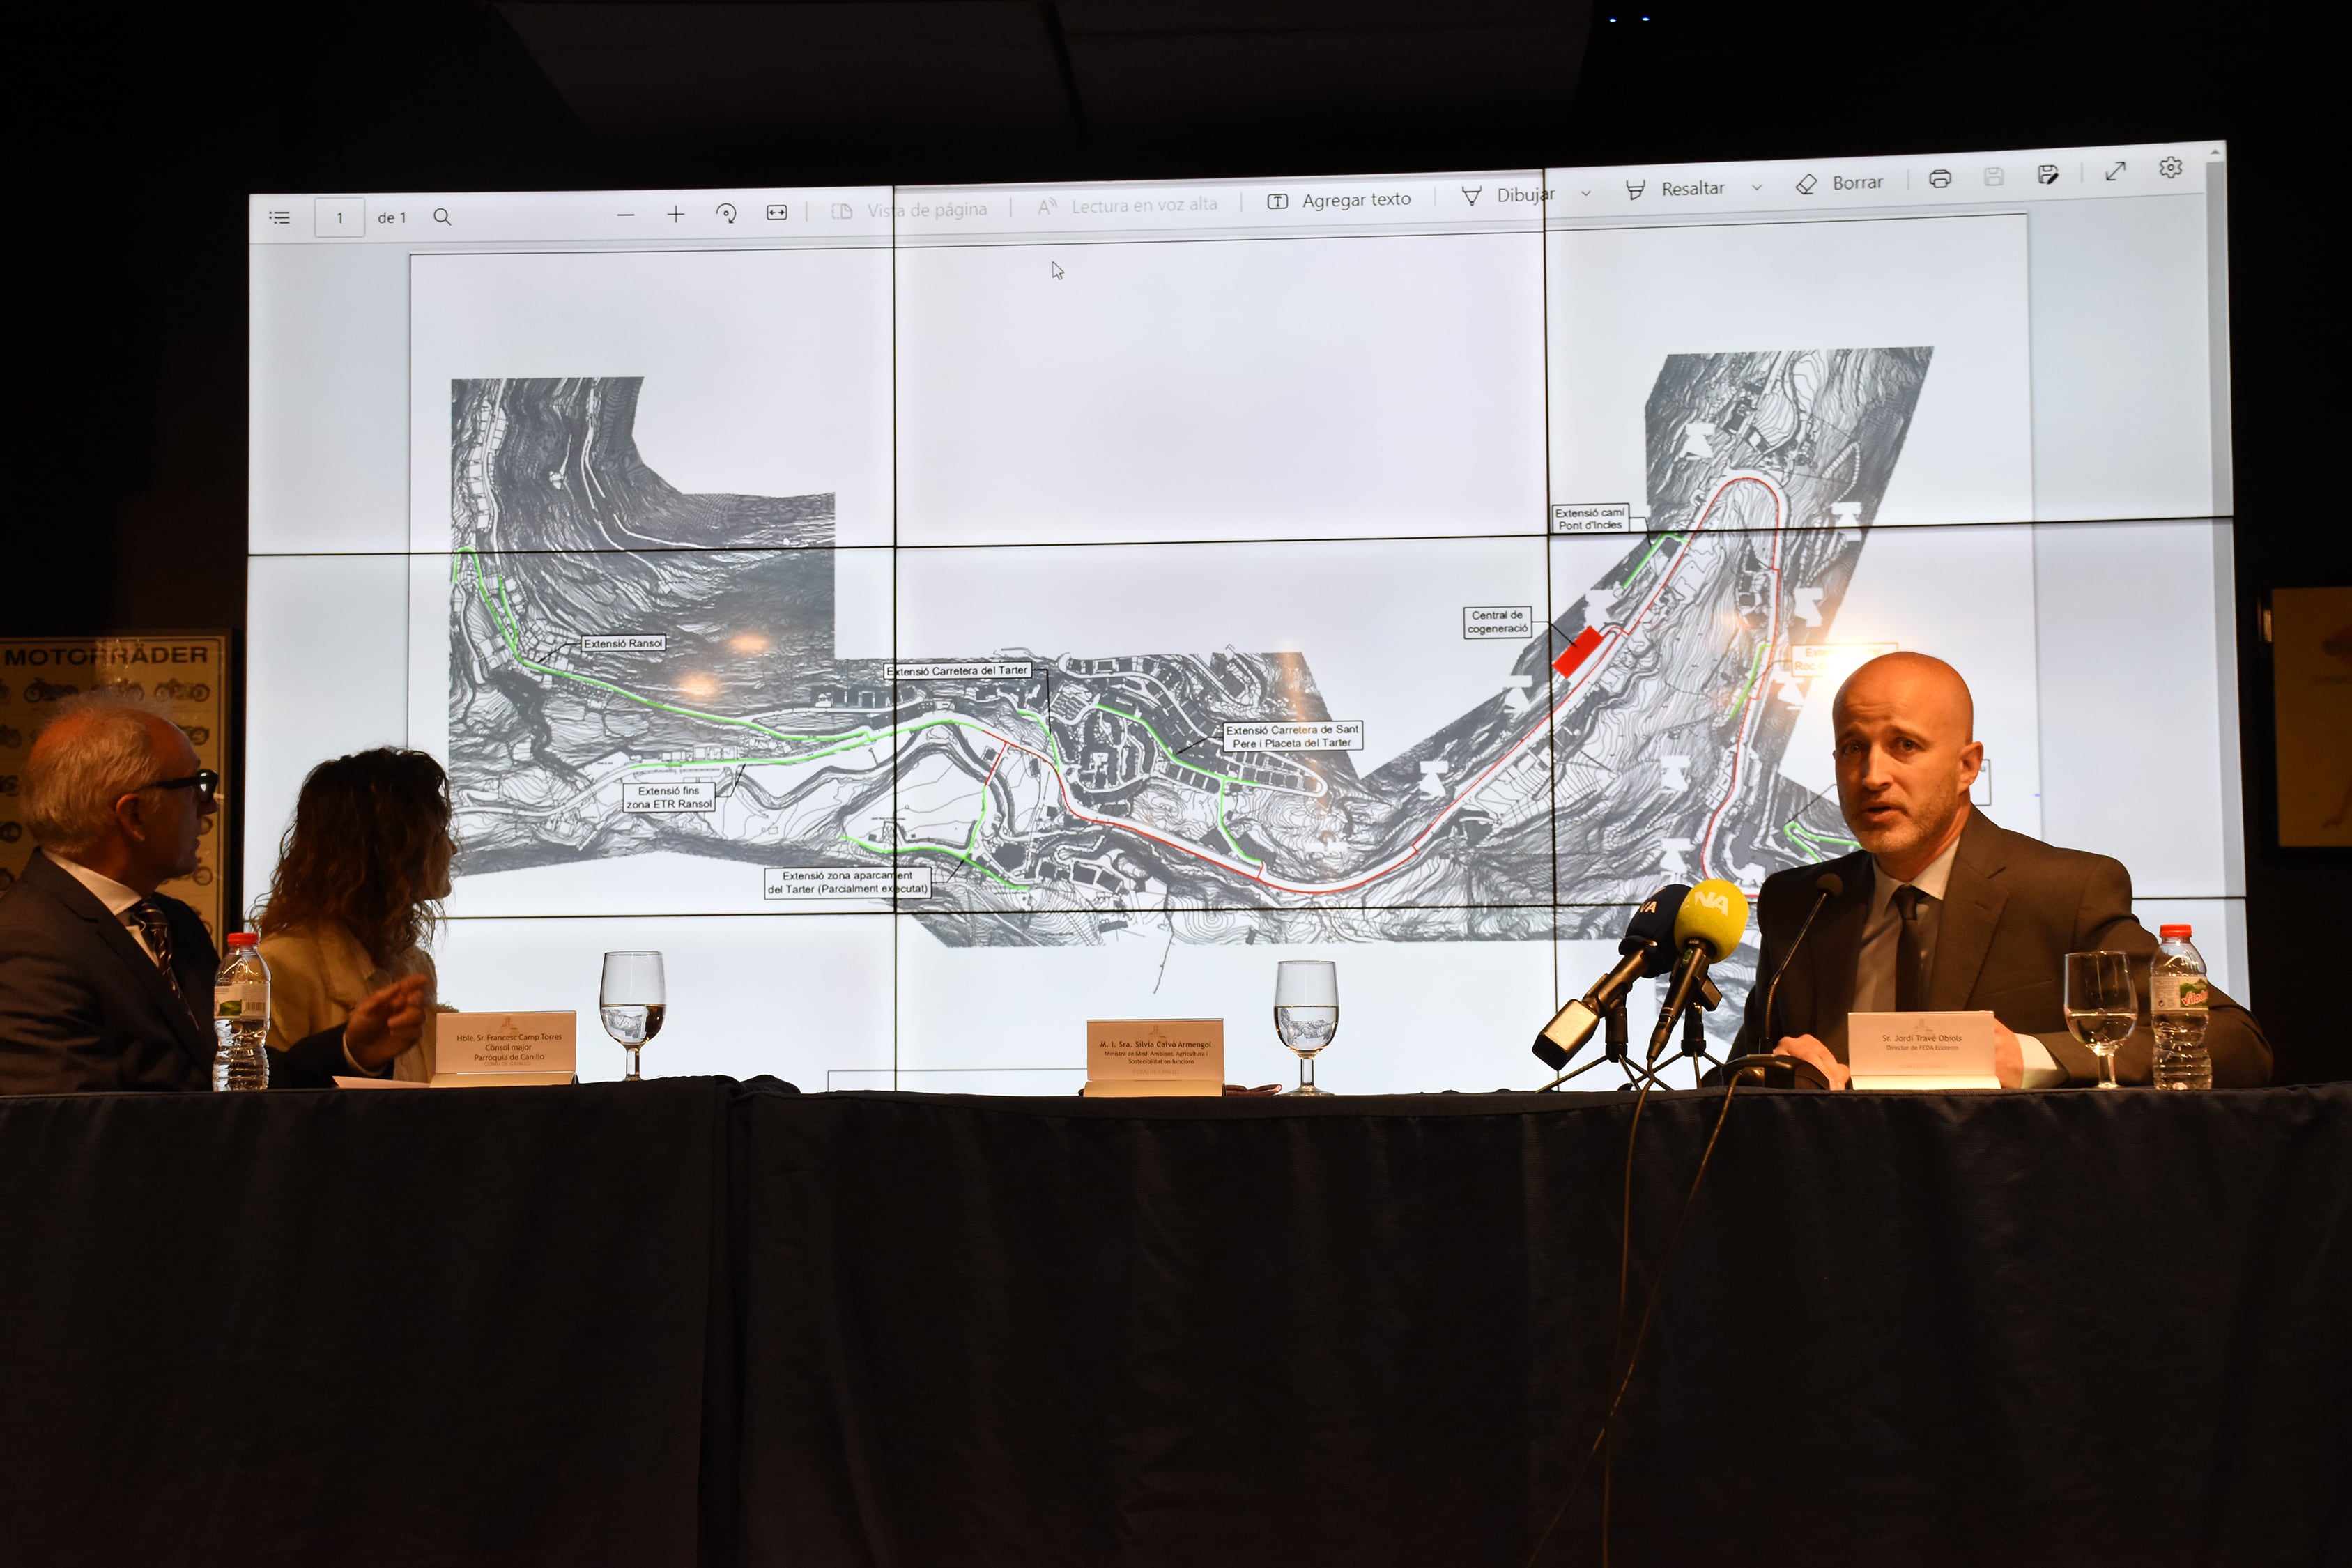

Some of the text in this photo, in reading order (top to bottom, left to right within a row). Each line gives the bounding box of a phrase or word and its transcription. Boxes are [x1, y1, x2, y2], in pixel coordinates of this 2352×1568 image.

[1663, 180, 1725, 196] Resaltar
[1834, 176, 1884, 190] Borrar
[1498, 187, 1555, 206] Dibujar
[1073, 196, 1218, 214] Lectura en voz alta
[1302, 193, 1411, 212] Agregar texto
[868, 202, 987, 221] Vista de página
[337, 212, 343, 224] 1
[378, 211, 406, 224] de 1
[1555, 507, 1625, 518] Extensió camí
[1559, 521, 1583, 530] Pont
[1471, 610, 1523, 620] Central de
[1467, 624, 1529, 636] cogeneració
[584, 638, 663, 649] Extensió Ransol
[4, 643, 209, 666] MOTORRÄDER
[886, 666, 1028, 677] Extensió Carretera del Tarter
[1226, 725, 1359, 735] Extensió Carretera de Sant
[1233, 739, 1257, 748] Pere
[1265, 739, 1302, 748] Placeta
[1305, 738, 1320, 747] del
[1323, 738, 1352, 747] Tarter
[638, 786, 700, 796] Extensió fins
[627, 799, 712, 809] zona ETR Ransol
[783, 871, 824, 881] Extensió
[854, 871, 913, 882] aparcament
[768, 884, 928, 895] del Tarter (Parcialment executat)
[518, 1034, 540, 1043] Camp
[1178, 1040, 1212, 1050] Armengol
[474, 1054, 508, 1063] Parròquia
